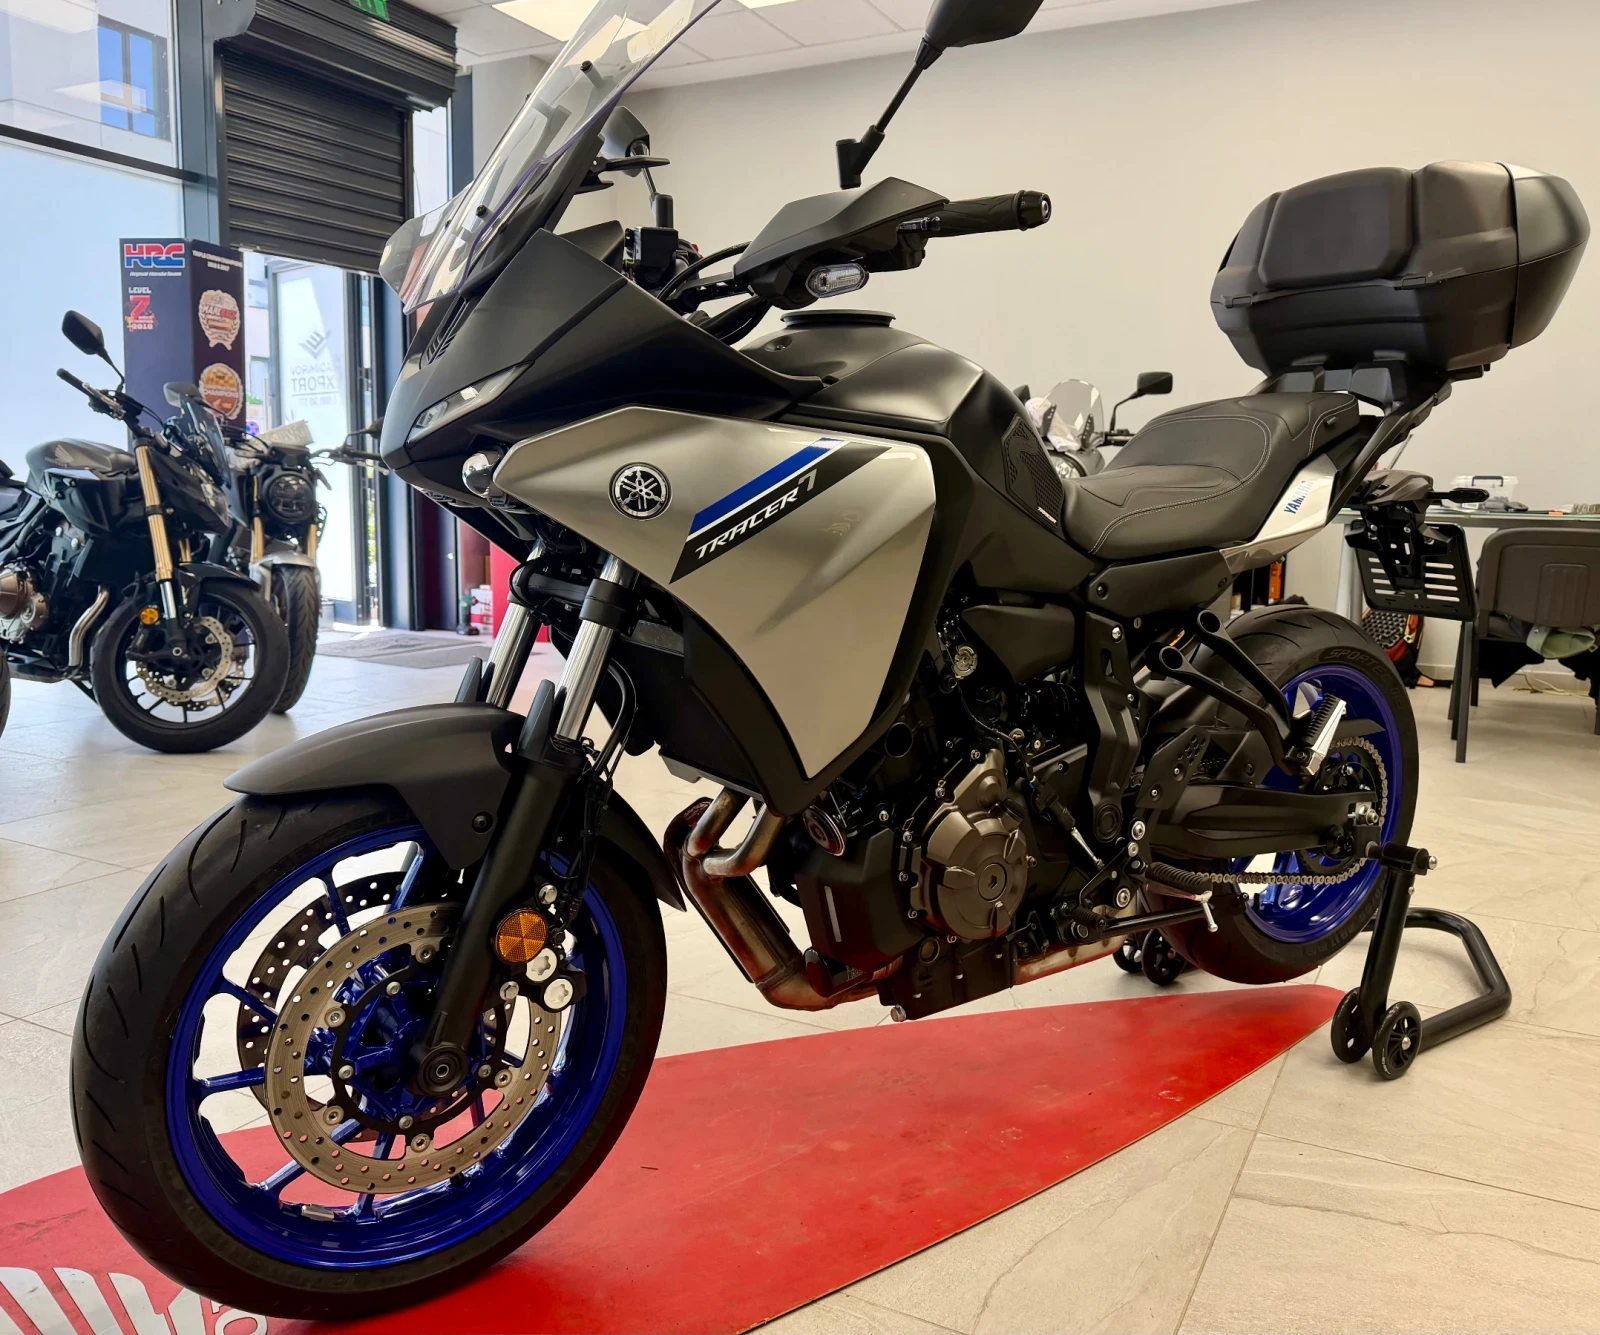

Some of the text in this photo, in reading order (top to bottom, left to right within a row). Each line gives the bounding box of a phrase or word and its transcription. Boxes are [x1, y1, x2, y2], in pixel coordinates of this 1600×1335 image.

[124, 243, 185, 268] HRC
[694, 468, 818, 560] TRACER 7
[1283, 480, 1315, 515] YAMAHA
[1325, 648, 1394, 684] SPORTEC
